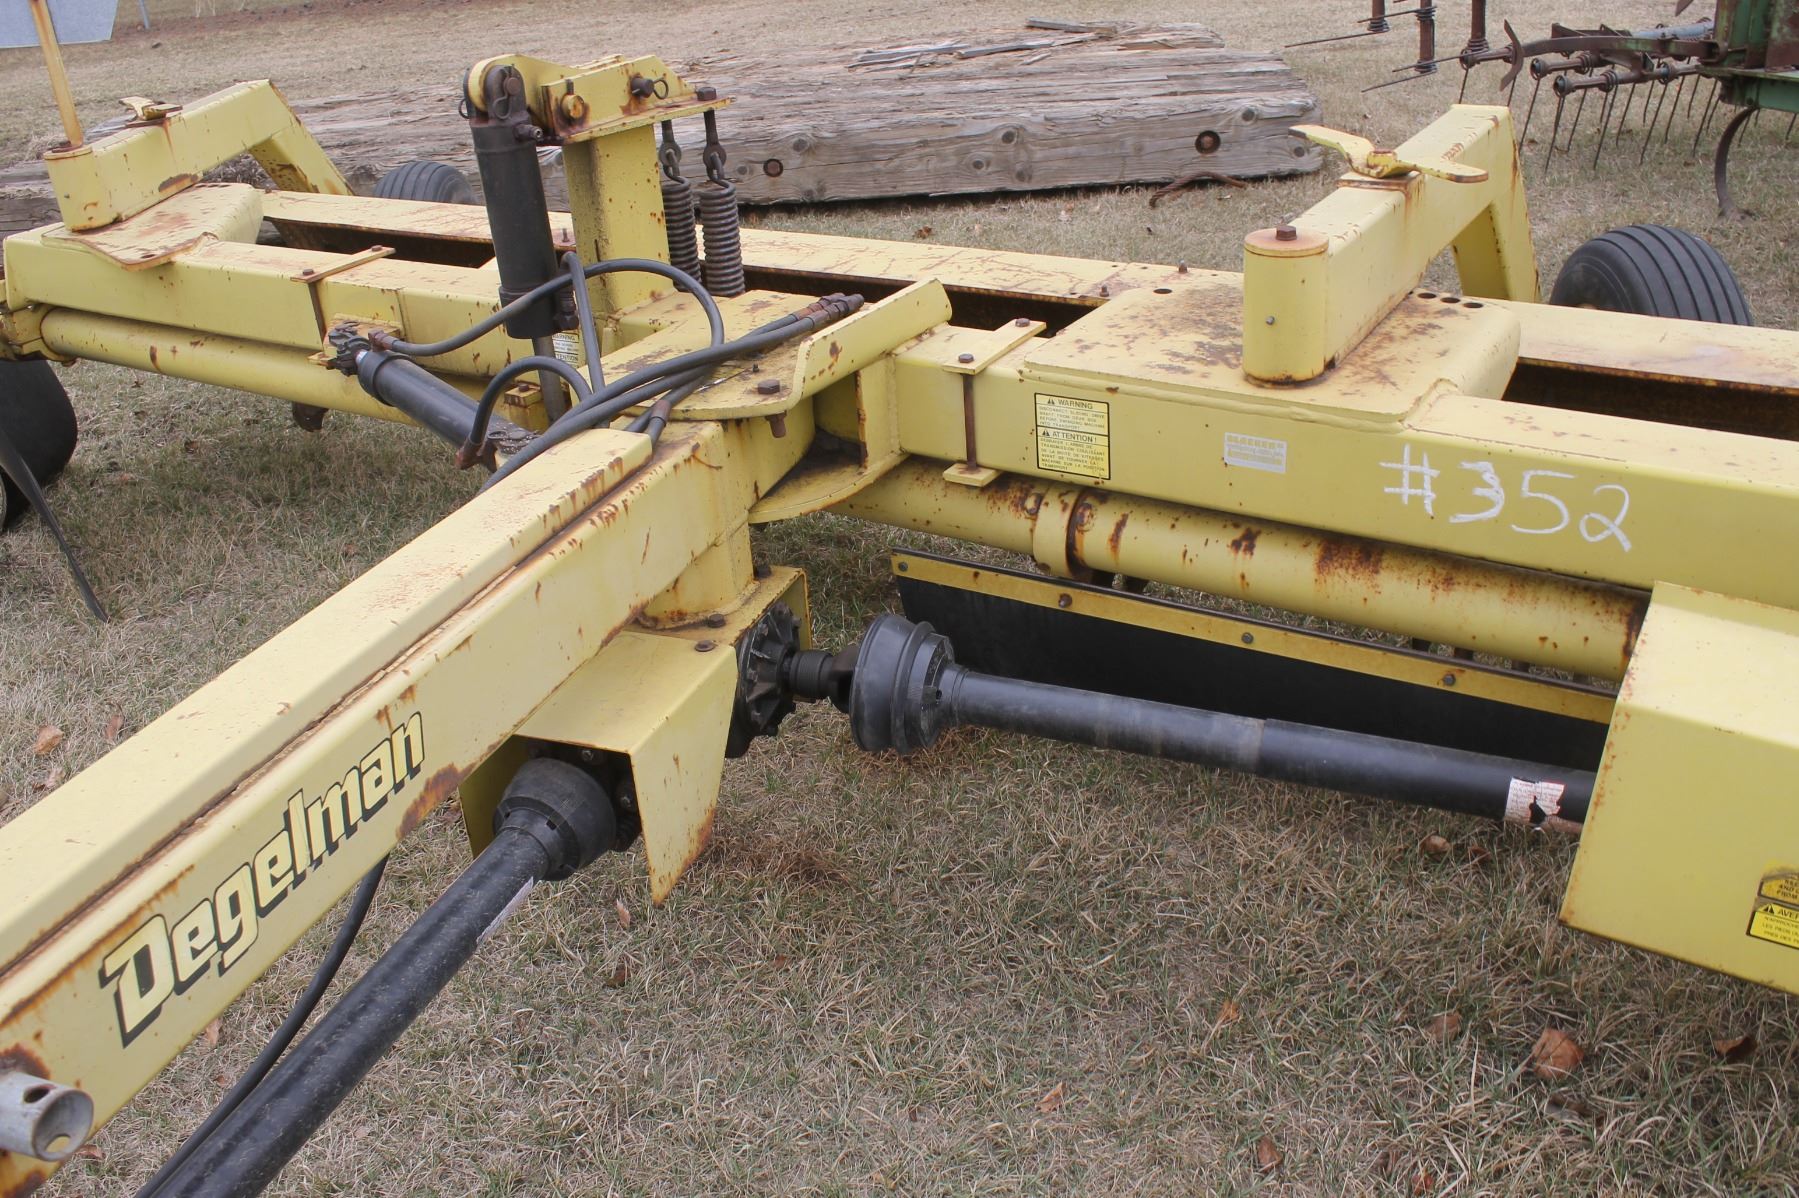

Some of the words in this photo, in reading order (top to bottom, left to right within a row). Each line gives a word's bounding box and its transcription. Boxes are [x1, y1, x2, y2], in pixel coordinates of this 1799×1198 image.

[1058, 399, 1093, 409] WARNING
[1379, 443, 1632, 552] #352
[98, 711, 425, 1050] Degelman
